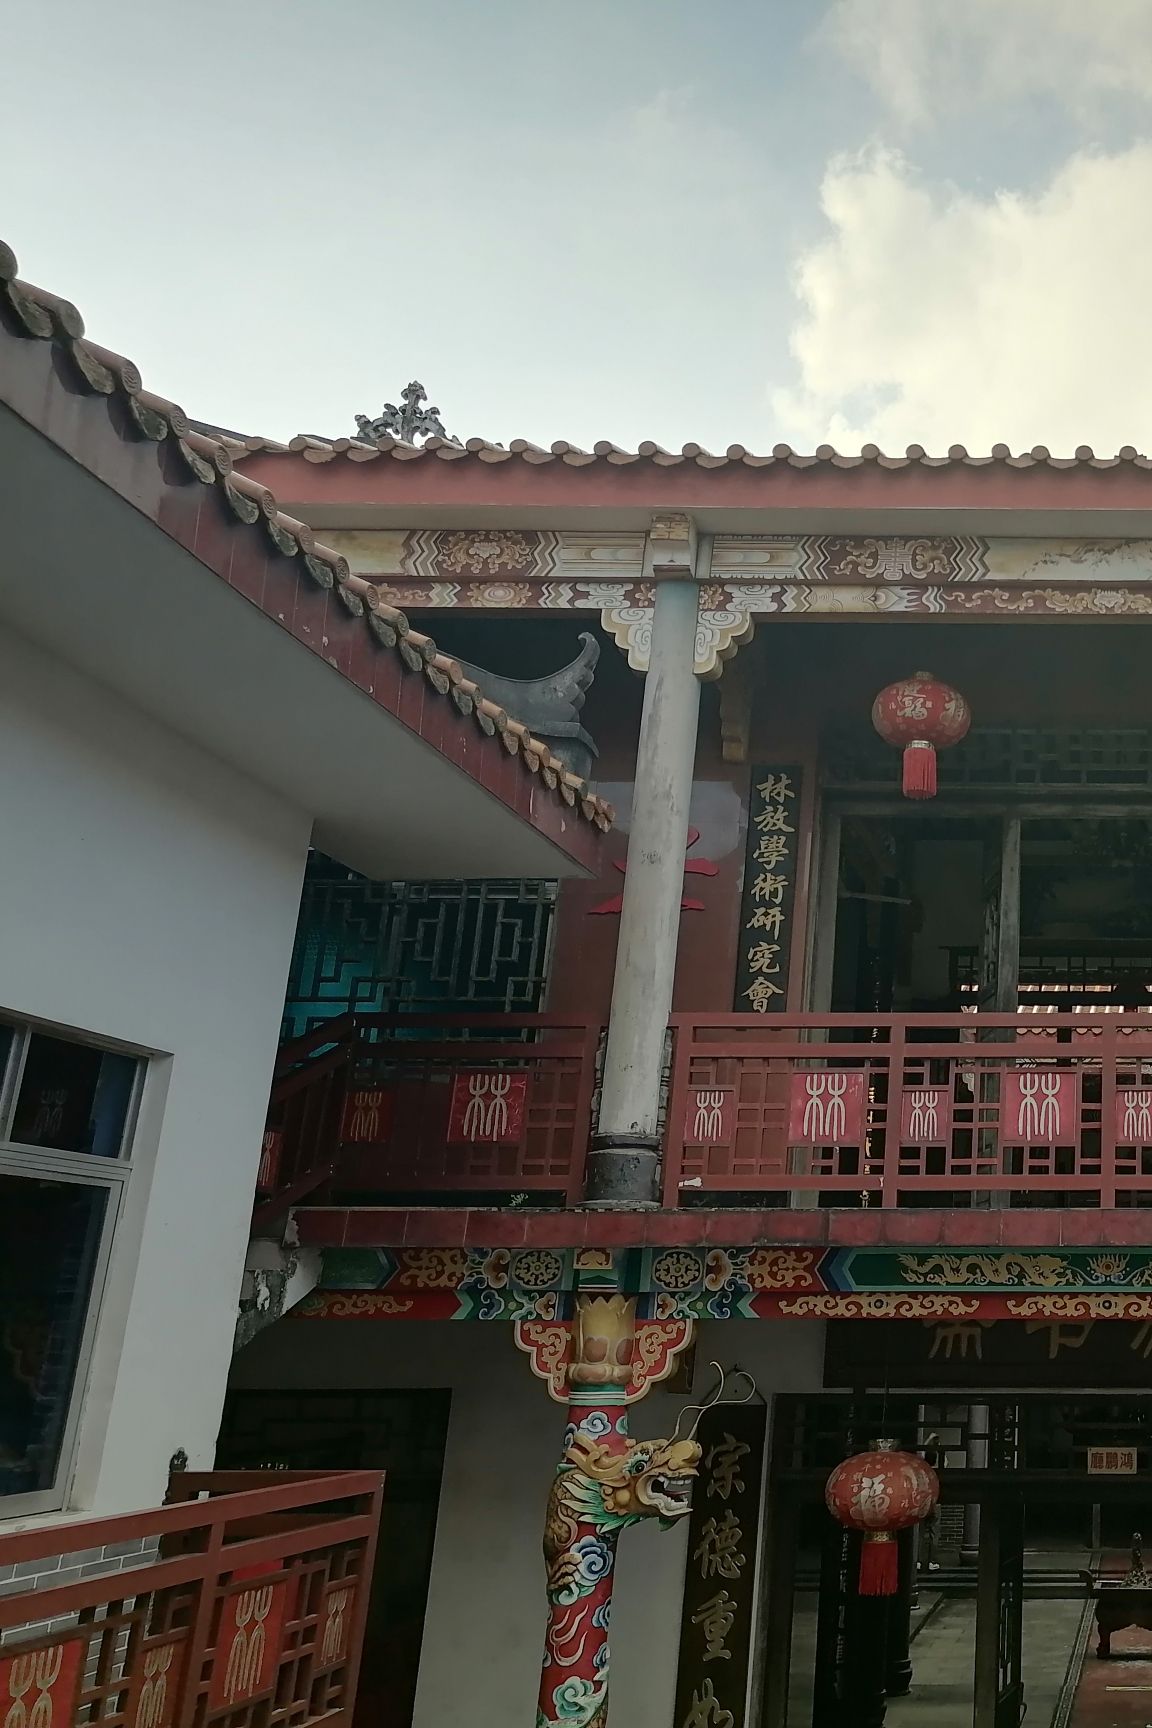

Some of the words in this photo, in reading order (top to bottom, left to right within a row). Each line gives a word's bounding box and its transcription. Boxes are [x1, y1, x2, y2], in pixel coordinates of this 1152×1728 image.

[740, 773, 796, 1014] 林放學術研究會
